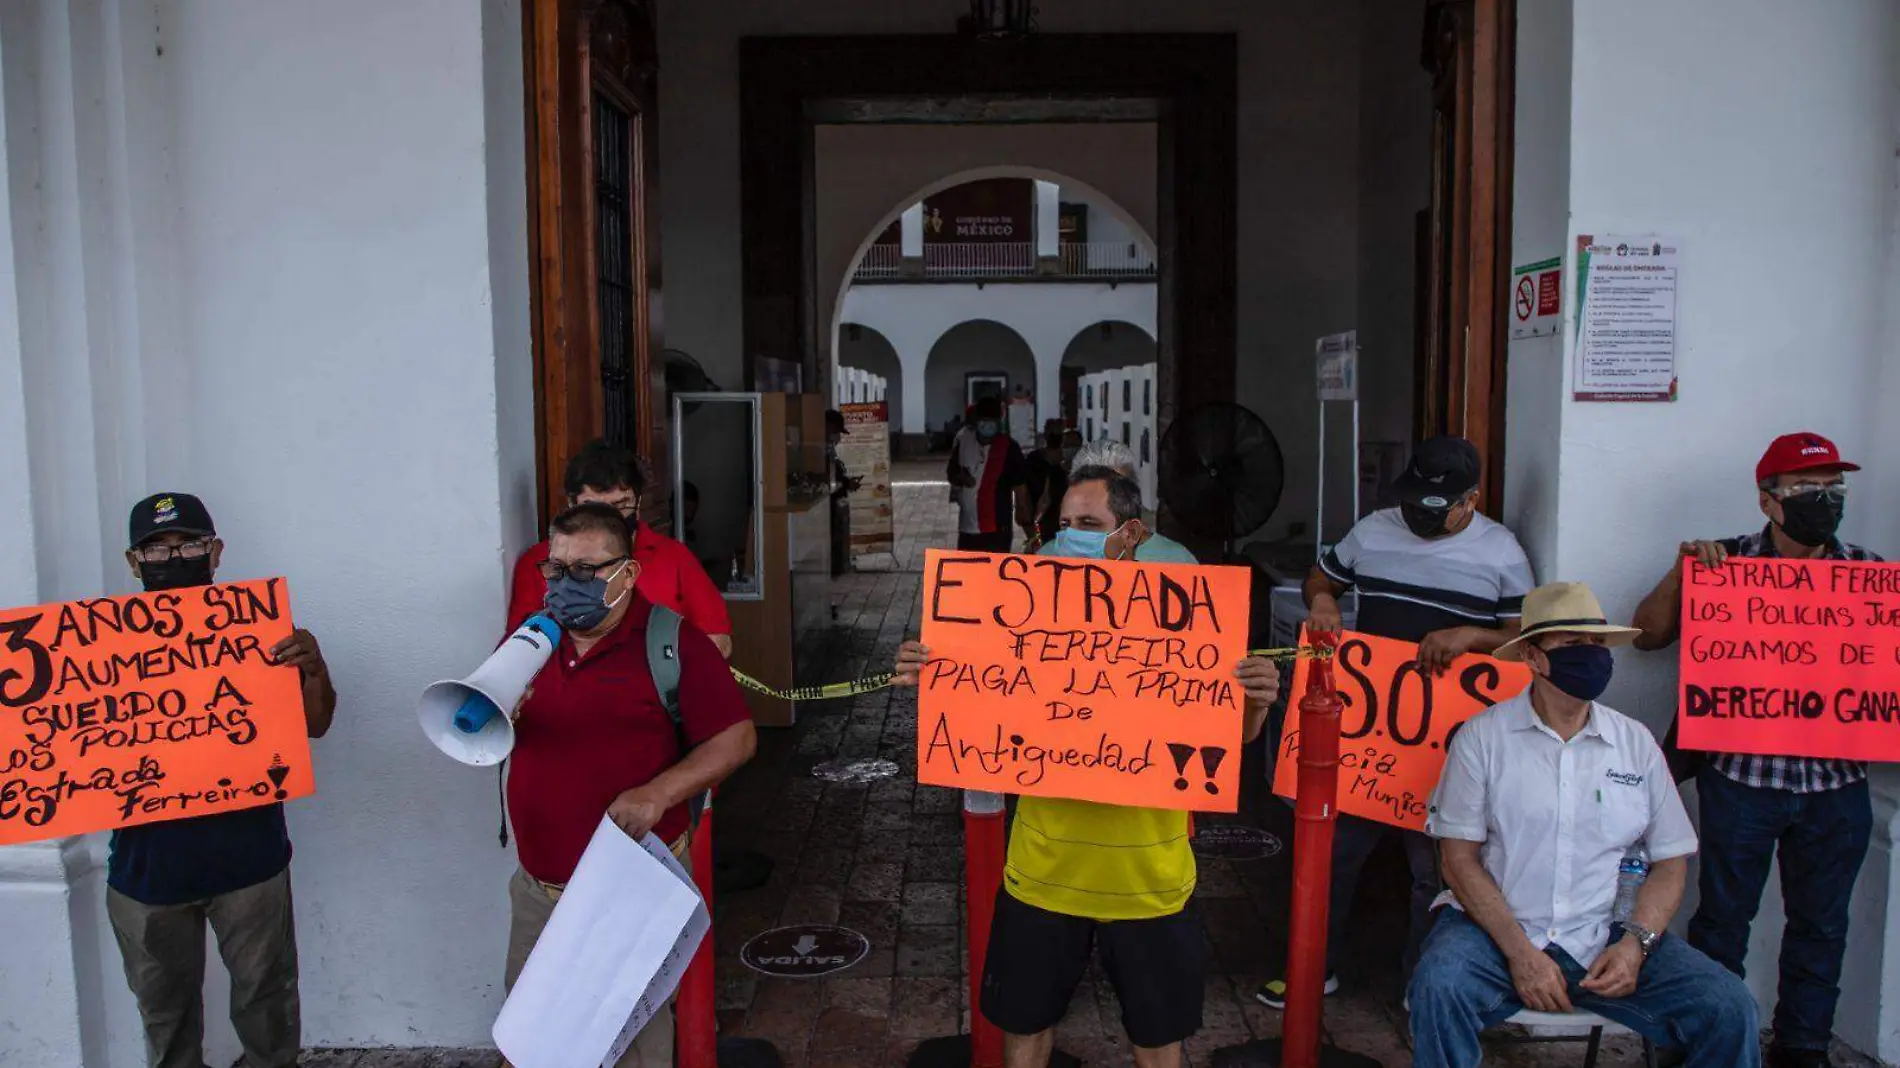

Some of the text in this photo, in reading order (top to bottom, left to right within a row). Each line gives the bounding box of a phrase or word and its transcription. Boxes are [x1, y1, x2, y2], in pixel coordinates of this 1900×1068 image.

[956, 224, 1013, 236] MÉXICO
[932, 556, 1221, 633] ESTRADA
[1690, 561, 1815, 592] ESTRADA
[1689, 598, 1733, 623] LOS
[1747, 597, 1855, 627] POLICIAS
[0, 577, 281, 708] 3 AÑOS SIN
[54, 632, 287, 695] AUMENTAR
[1007, 629, 1220, 671] FERREIRO
[1689, 635, 1818, 666] GOZAMOS
[1839, 643, 1876, 666] DE
[924, 658, 1036, 696] PAGA
[1063, 668, 1117, 698] LA
[1127, 669, 1236, 710] PRIMA
[1684, 684, 1828, 720] DERECHO
[22, 676, 253, 745] SUELDO A
[70, 709, 258, 757] POLICIAS
